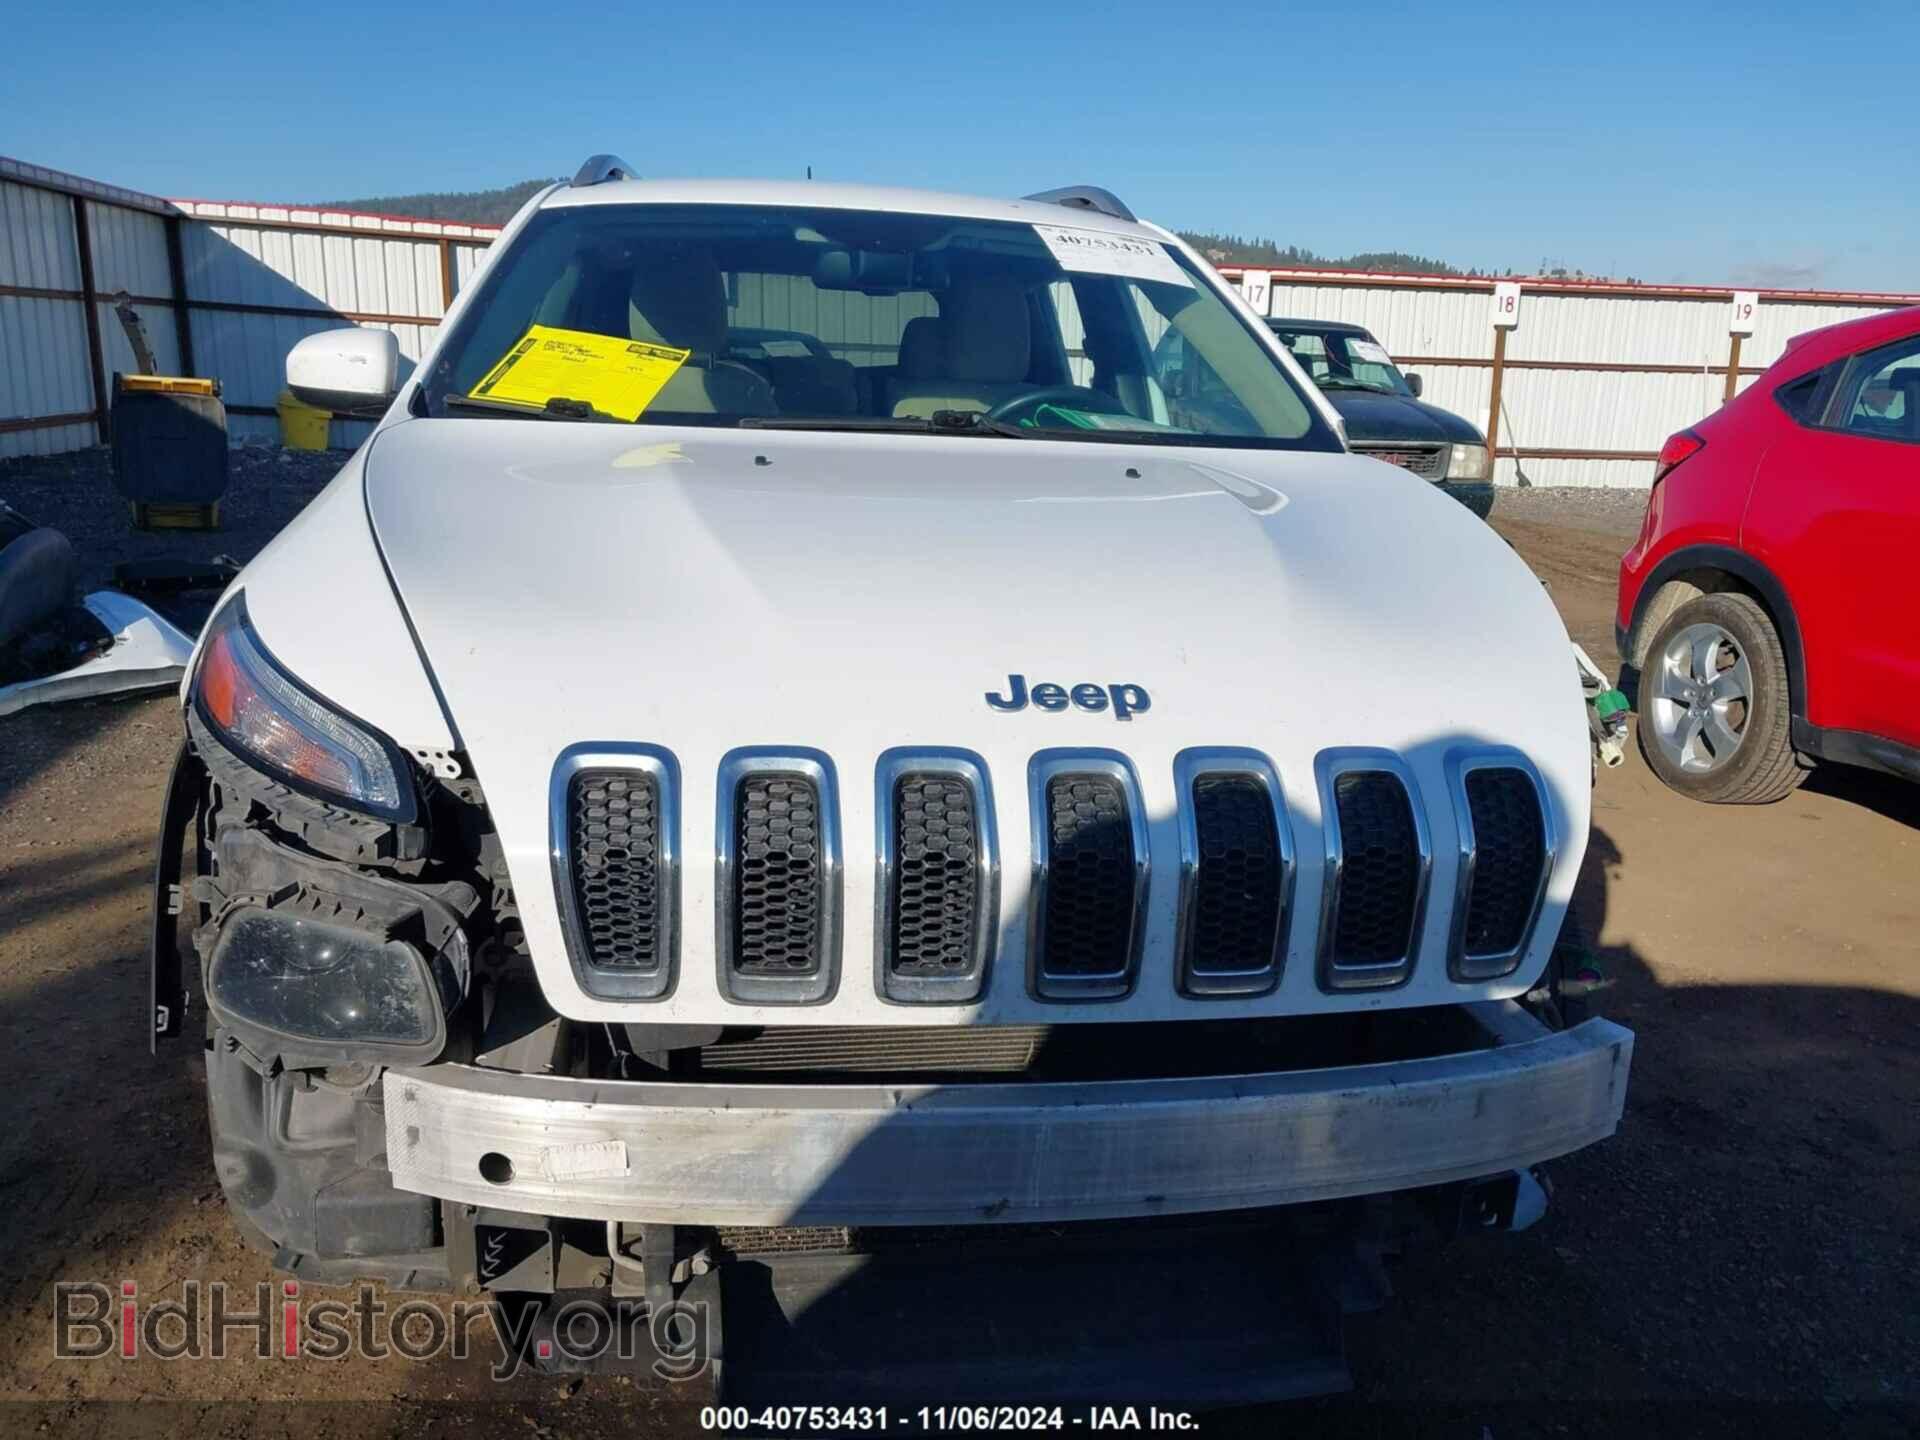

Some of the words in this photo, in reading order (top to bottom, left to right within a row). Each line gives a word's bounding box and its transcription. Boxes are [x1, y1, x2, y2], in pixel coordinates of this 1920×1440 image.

[1248, 285, 1265, 303] 17
[1498, 295, 1515, 313] 18
[1735, 303, 1753, 321] 19
[985, 674, 1151, 721] Jeep
